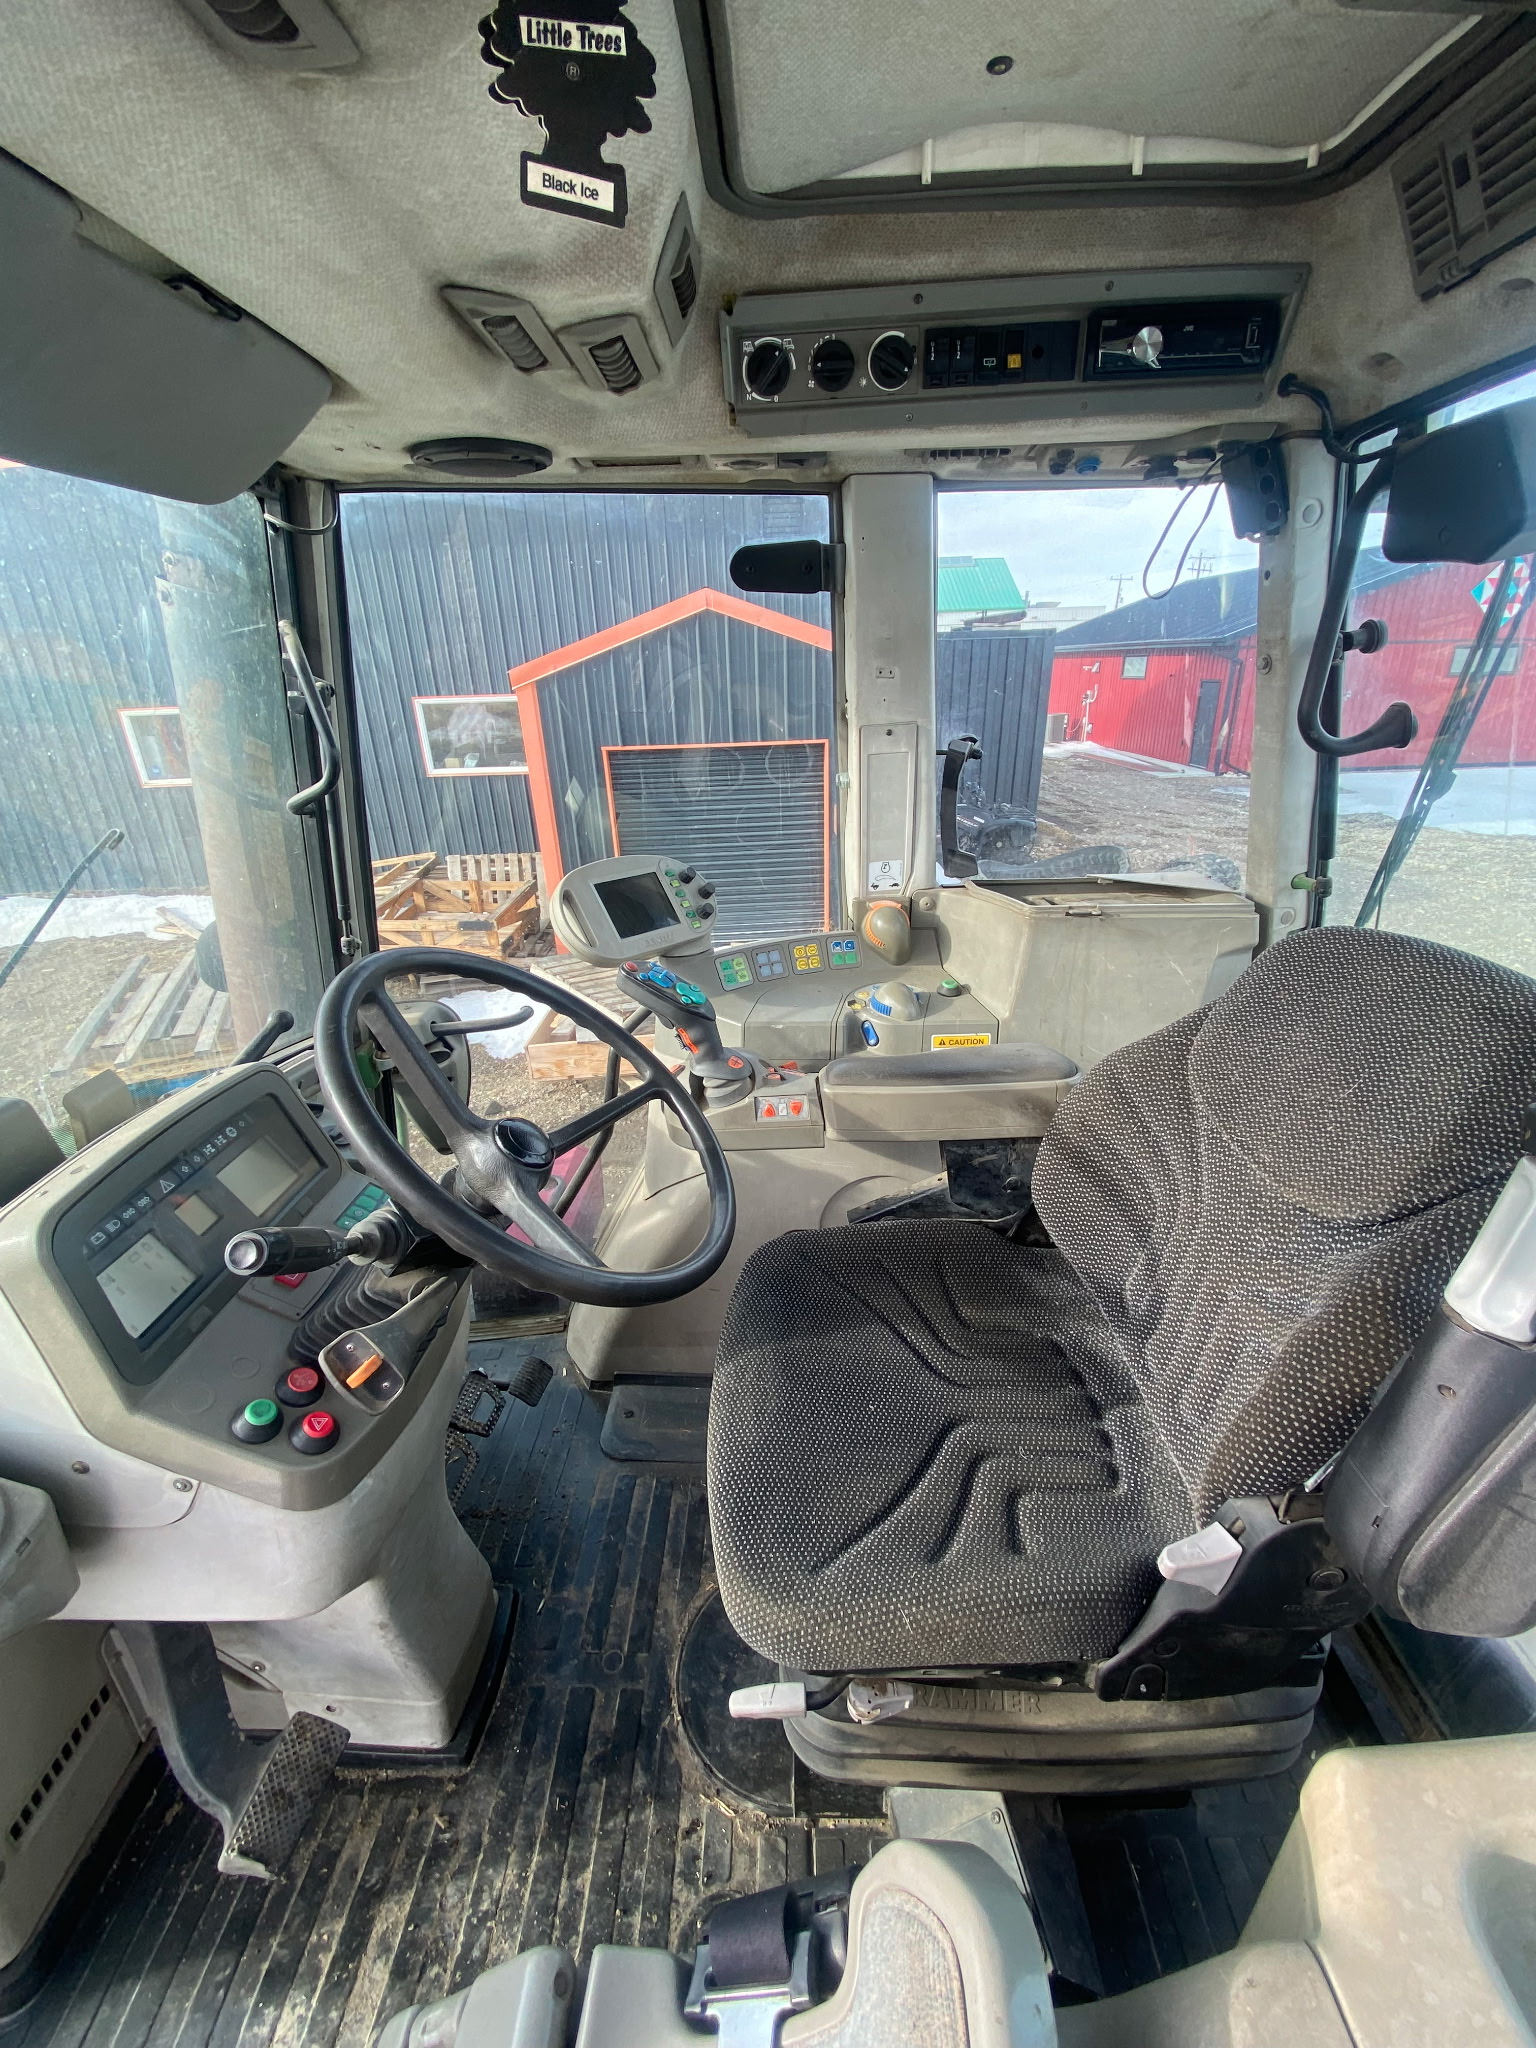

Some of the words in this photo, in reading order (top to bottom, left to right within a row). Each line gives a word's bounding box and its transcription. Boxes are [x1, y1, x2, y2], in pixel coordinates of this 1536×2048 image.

[527, 18, 572, 47] Little
[576, 25, 622, 53] Trees
[542, 173, 577, 195] Black
[580, 183, 599, 200] Ice
[948, 1038, 985, 1046] CAUTION
[914, 1685, 1042, 1713] RAMMER
